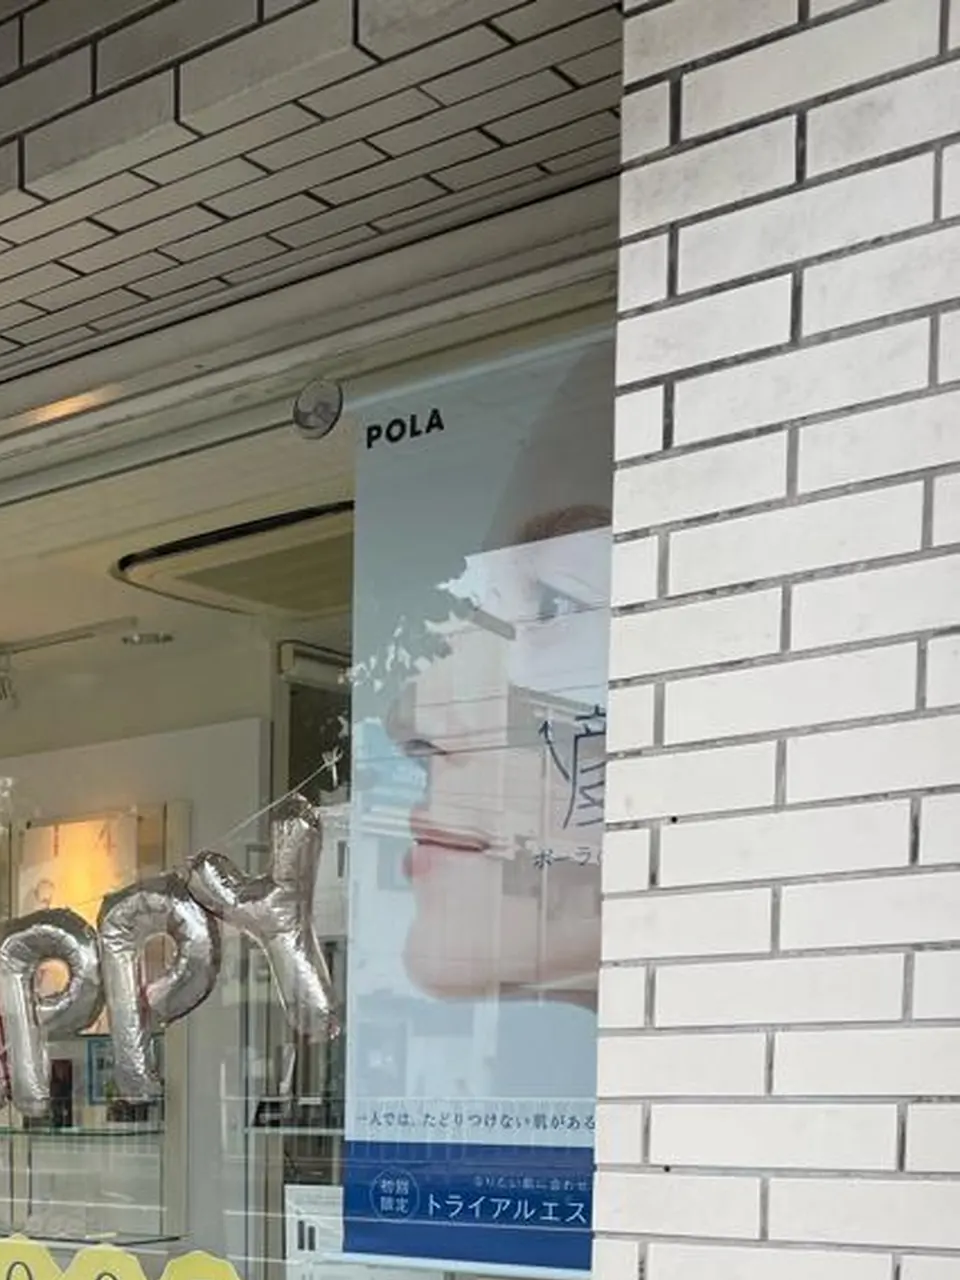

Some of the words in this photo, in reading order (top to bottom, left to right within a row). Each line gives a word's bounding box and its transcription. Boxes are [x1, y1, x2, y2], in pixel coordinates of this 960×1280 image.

[366, 408, 445, 449] POLA
[534, 846, 601, 869] ポーラ
[427, 1193, 588, 1225] トライアルエス
